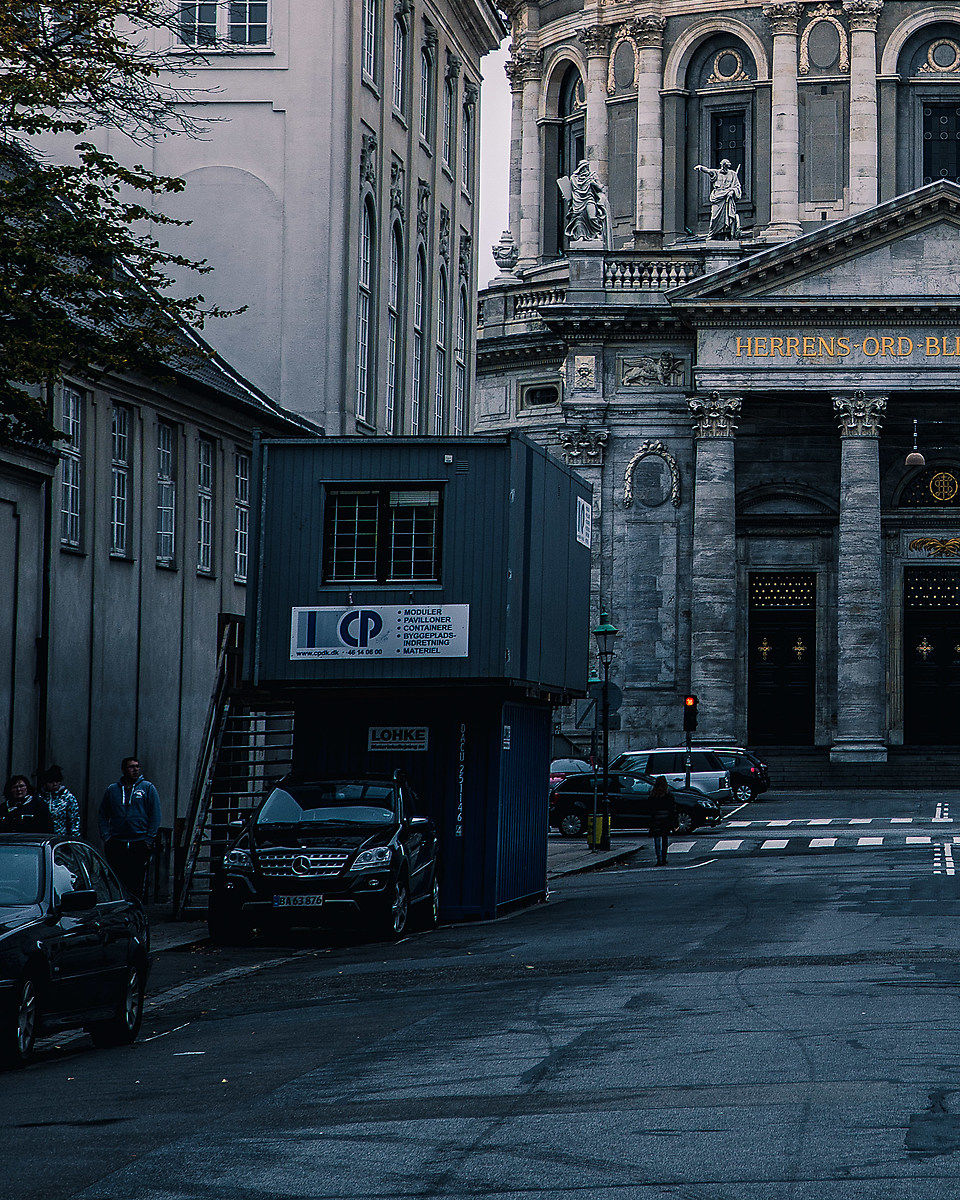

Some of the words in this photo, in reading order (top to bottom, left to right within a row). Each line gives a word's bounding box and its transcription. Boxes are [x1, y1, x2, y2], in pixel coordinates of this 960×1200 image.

[735, 336, 851, 357] HERRENS
[859, 336, 913, 357] ORD
[404, 608, 442, 616] MODULER
[403, 616, 451, 624] PAVILLONER
[403, 624, 453, 632] CONTAINERE
[403, 632, 457, 640] BYGGEPLADS-
[403, 639, 450, 647] INDRETNING
[403, 647, 441, 655] MATERIEL
[371, 729, 426, 742] LOHKE
